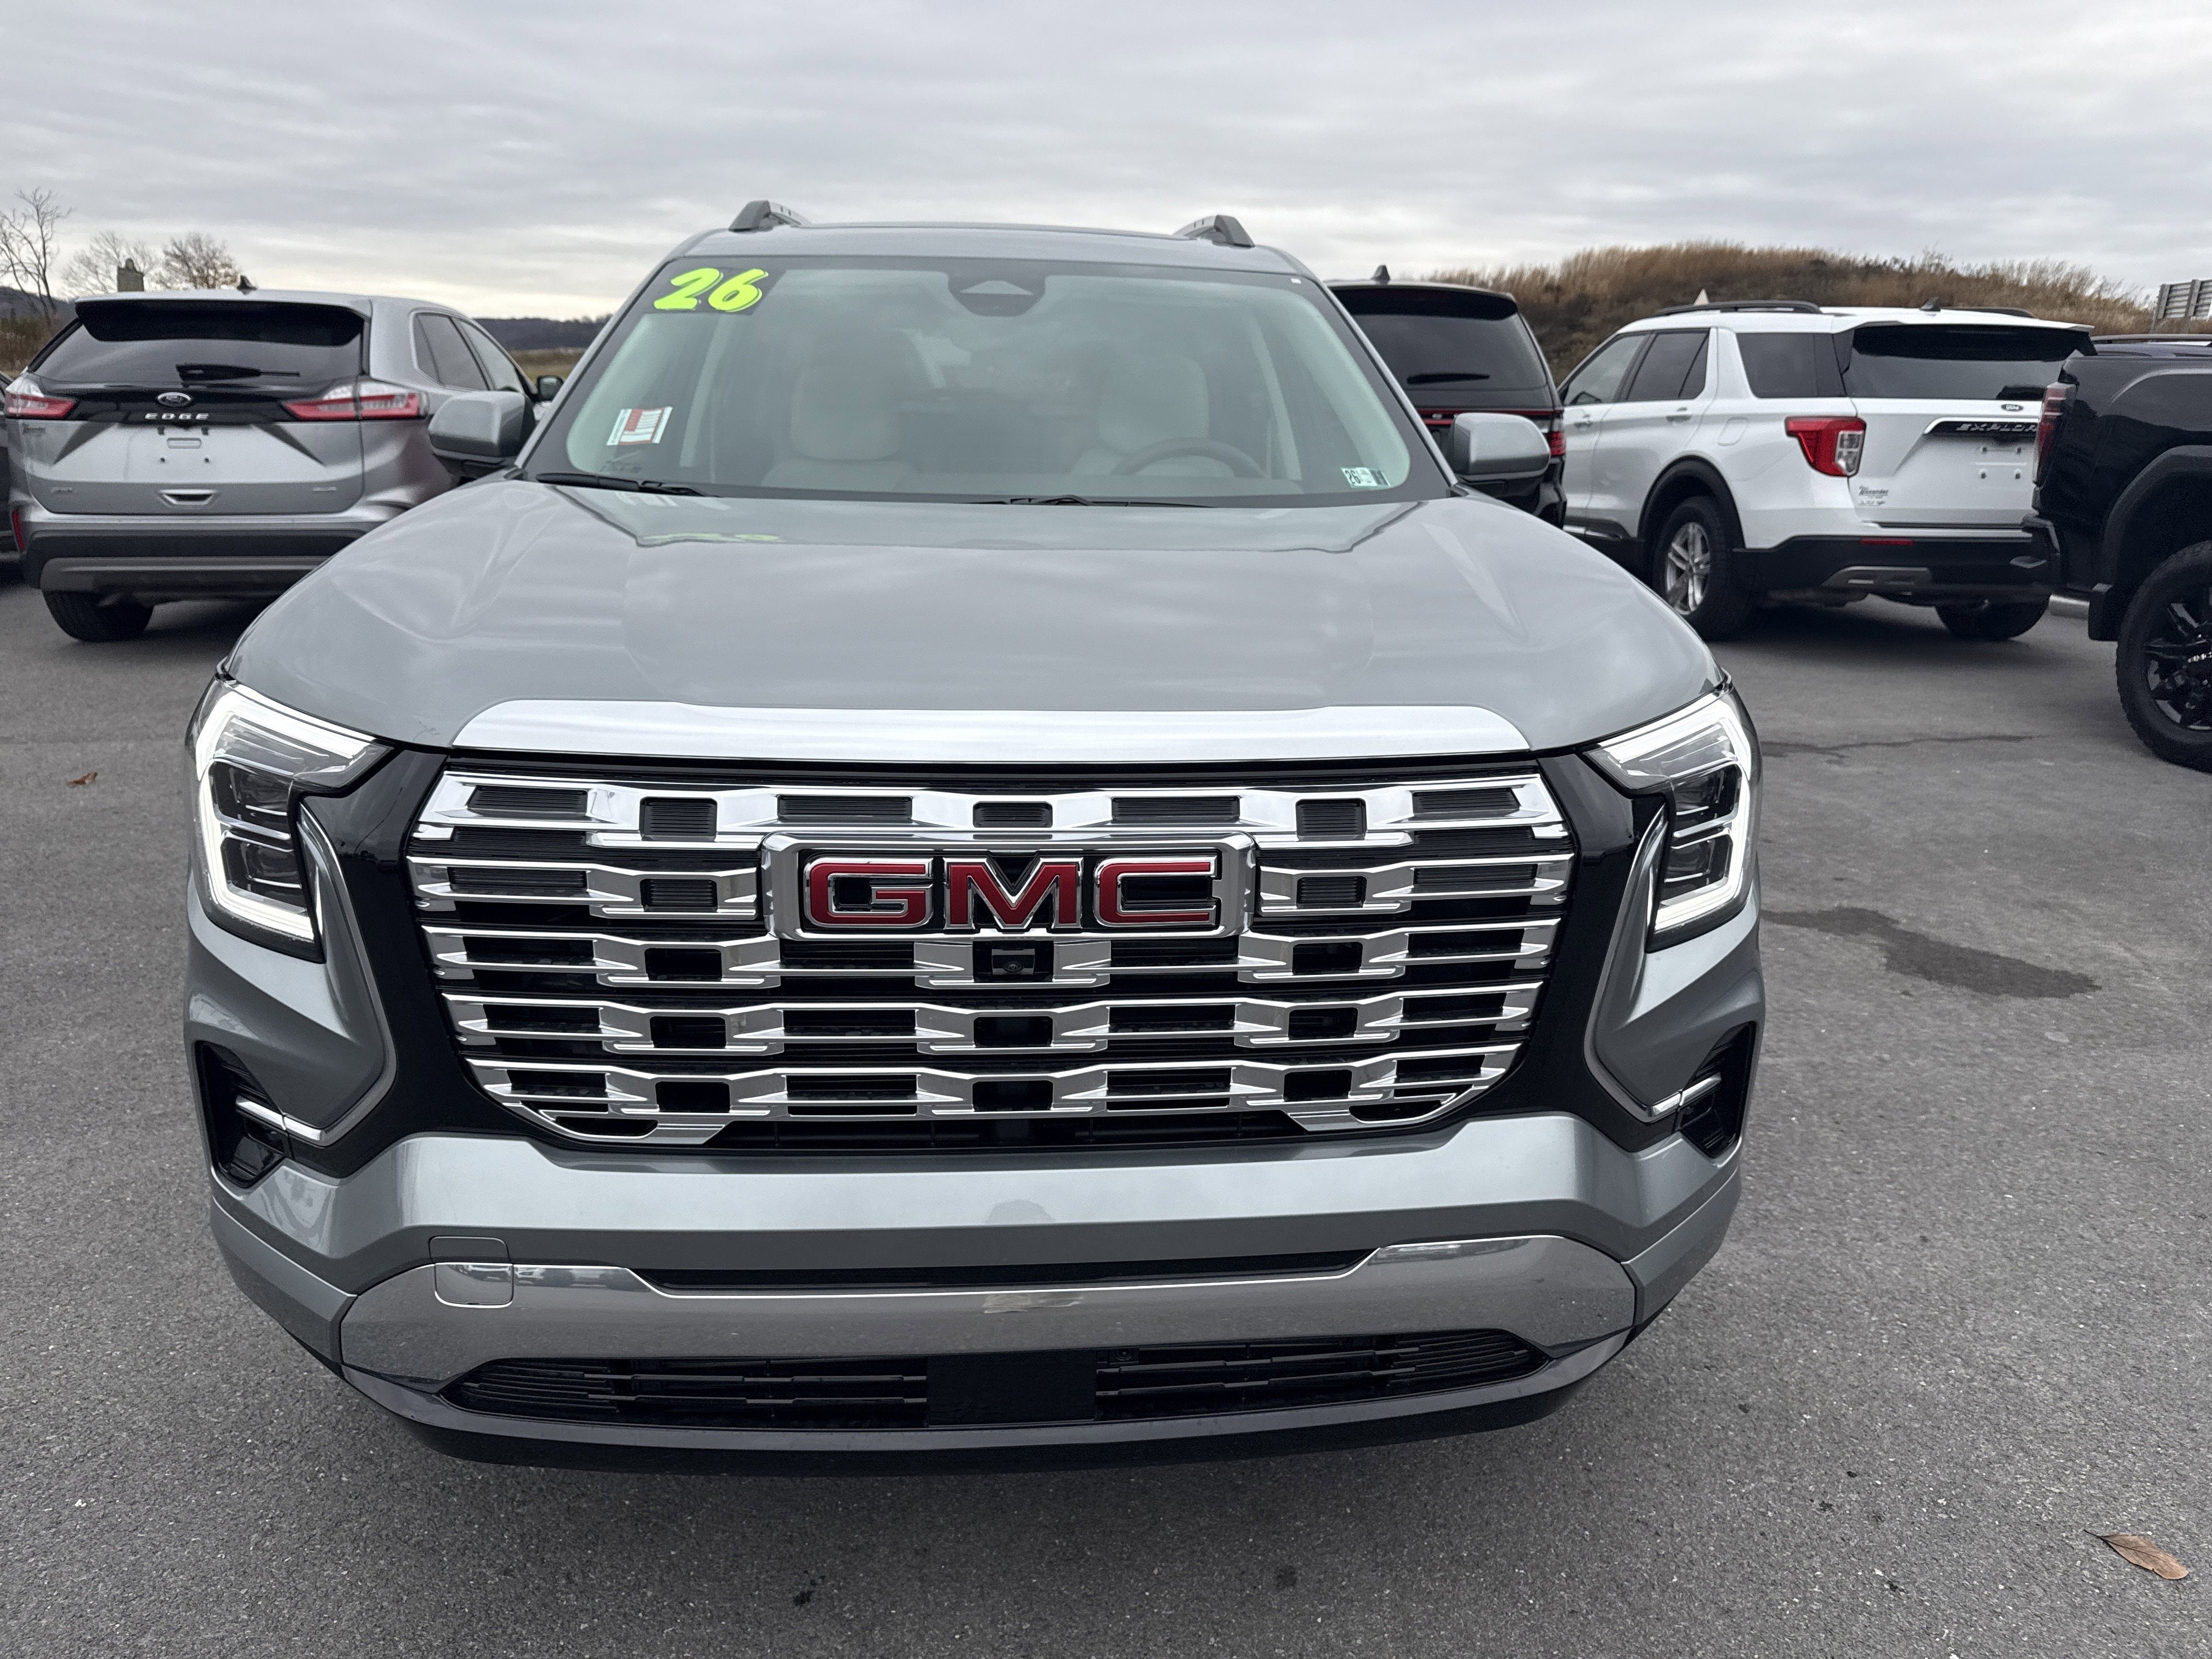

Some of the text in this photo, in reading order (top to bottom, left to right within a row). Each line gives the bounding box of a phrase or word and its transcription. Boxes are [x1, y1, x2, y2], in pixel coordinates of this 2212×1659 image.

[654, 268, 769, 312] 26
[1345, 470, 1361, 484] 26
[804, 856, 1217, 931] GMC
